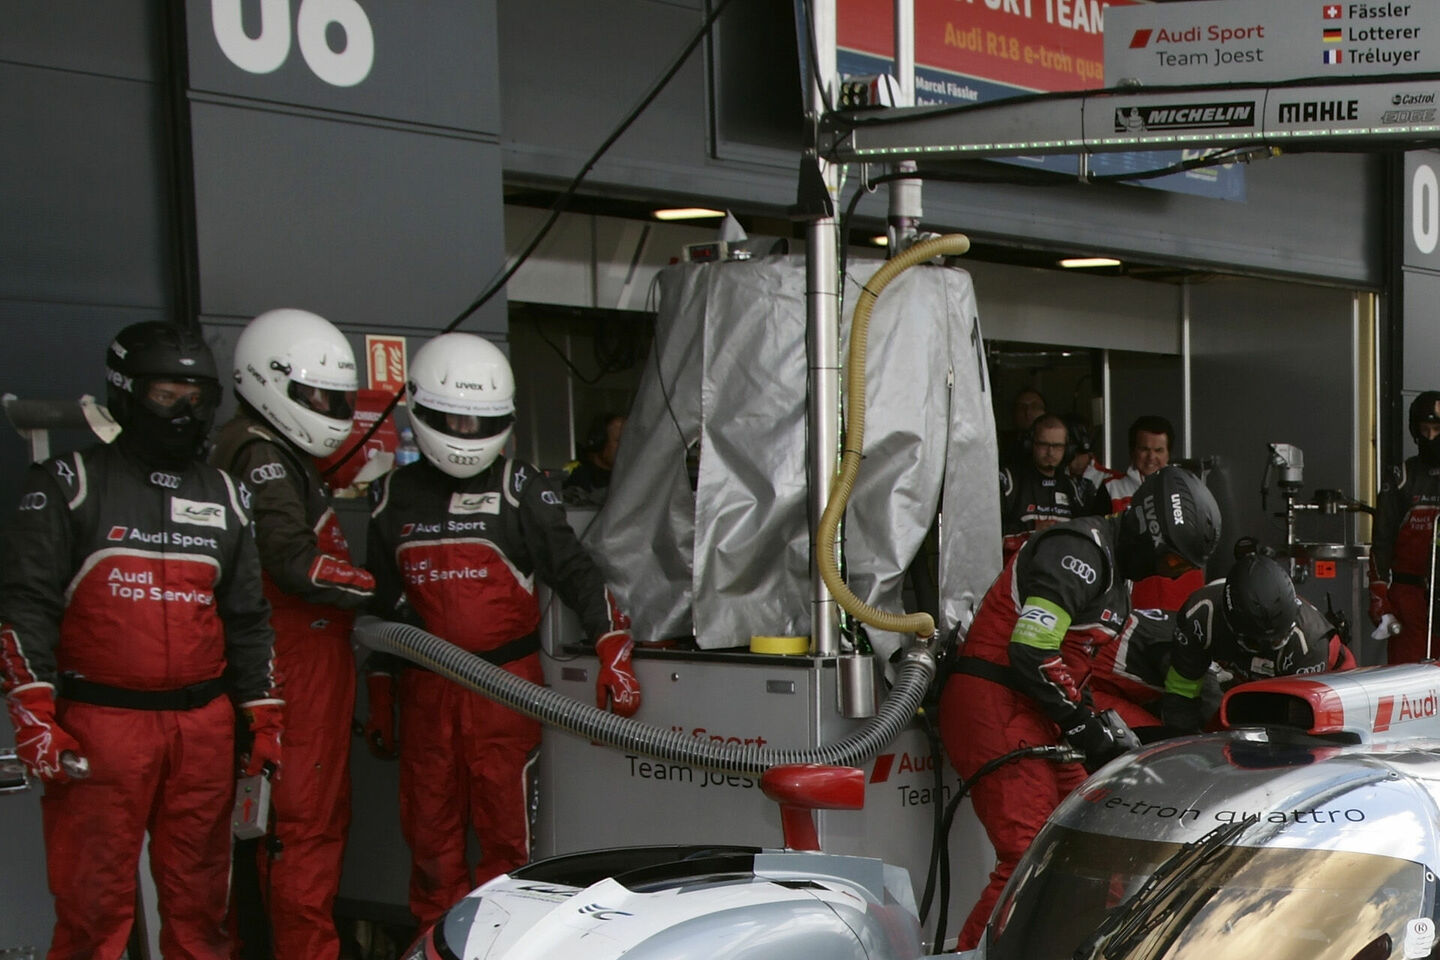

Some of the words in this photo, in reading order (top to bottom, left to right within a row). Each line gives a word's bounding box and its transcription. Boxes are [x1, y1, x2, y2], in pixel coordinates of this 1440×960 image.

[1348, 3, 1412, 19] Fässler
[1156, 27, 1201, 44] Audi
[1207, 24, 1266, 46] Sport
[1348, 26, 1421, 42] Lotterer
[944, 23, 983, 52] Audi
[986, 31, 1021, 61] R18
[1023, 44, 1073, 73] e-tron
[1156, 51, 1208, 66] Team
[1213, 48, 1265, 65] Joest
[1348, 48, 1421, 66] Tréluyer
[1402, 93, 1436, 105] Castrol
[1148, 105, 1252, 125] MICHELIN
[1278, 100, 1359, 123] MAHLE
[455, 380, 484, 392] uvex
[1170, 493, 1184, 525] uvex
[447, 519, 486, 533] Sport
[1143, 495, 1164, 548] uvex
[129, 528, 169, 544] Audi
[172, 532, 218, 549] Sport
[108, 567, 154, 585] Audi
[429, 567, 489, 583] Service
[108, 583, 146, 602] Top
[149, 587, 216, 606] Service
[1399, 690, 1438, 721] Audi
[625, 755, 693, 783] Team
[897, 785, 951, 807] Team
[1105, 794, 1201, 823] e-tron
[1213, 806, 1367, 825] quattro
